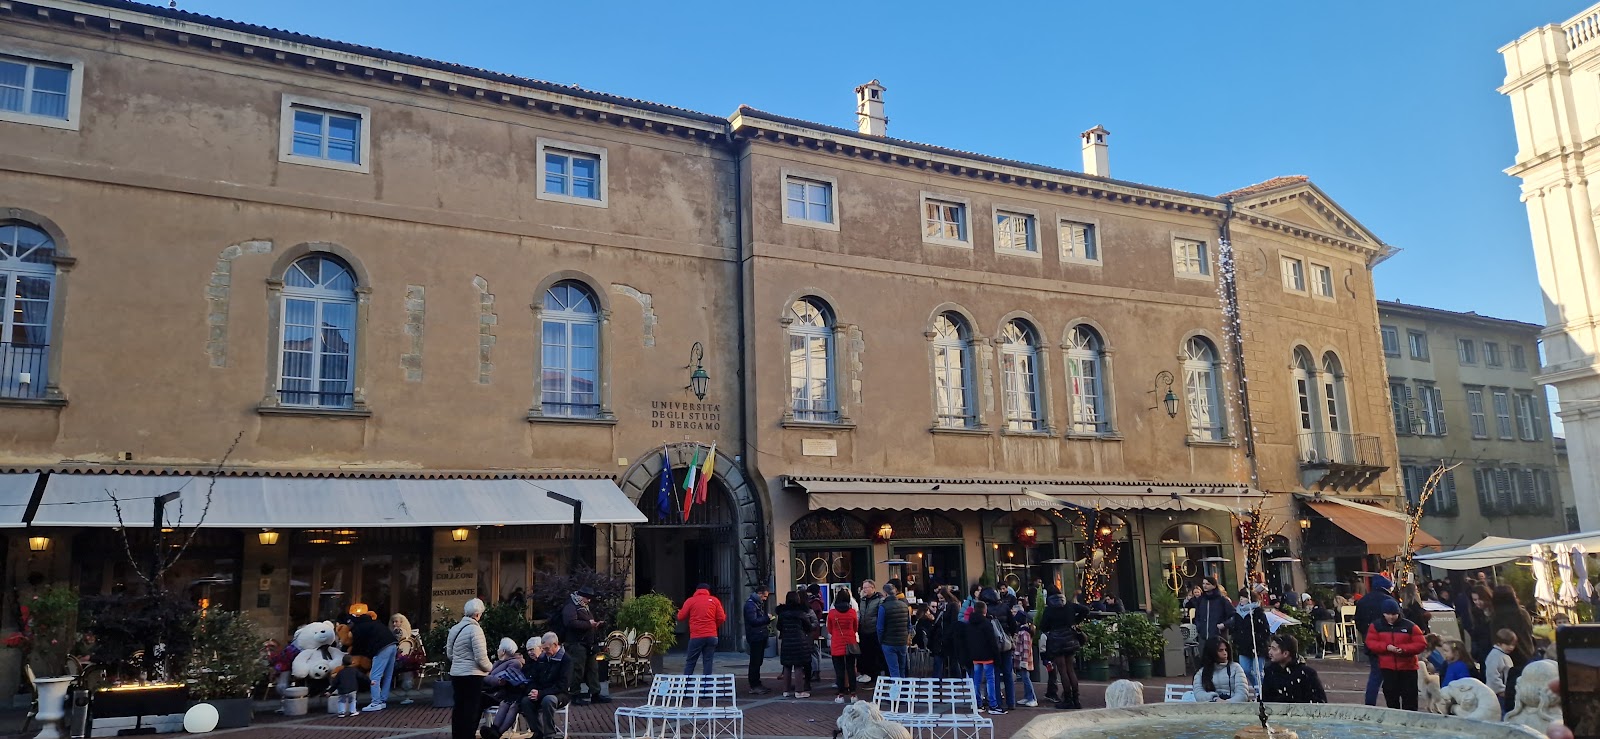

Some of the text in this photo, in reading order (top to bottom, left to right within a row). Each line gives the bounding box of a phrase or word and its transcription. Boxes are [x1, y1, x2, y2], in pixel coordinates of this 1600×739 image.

[652, 410, 721, 421] DEGLI STUDI
[652, 420, 721, 431] DI BERGAMO
[432, 588, 476, 597] RISTORANTE
